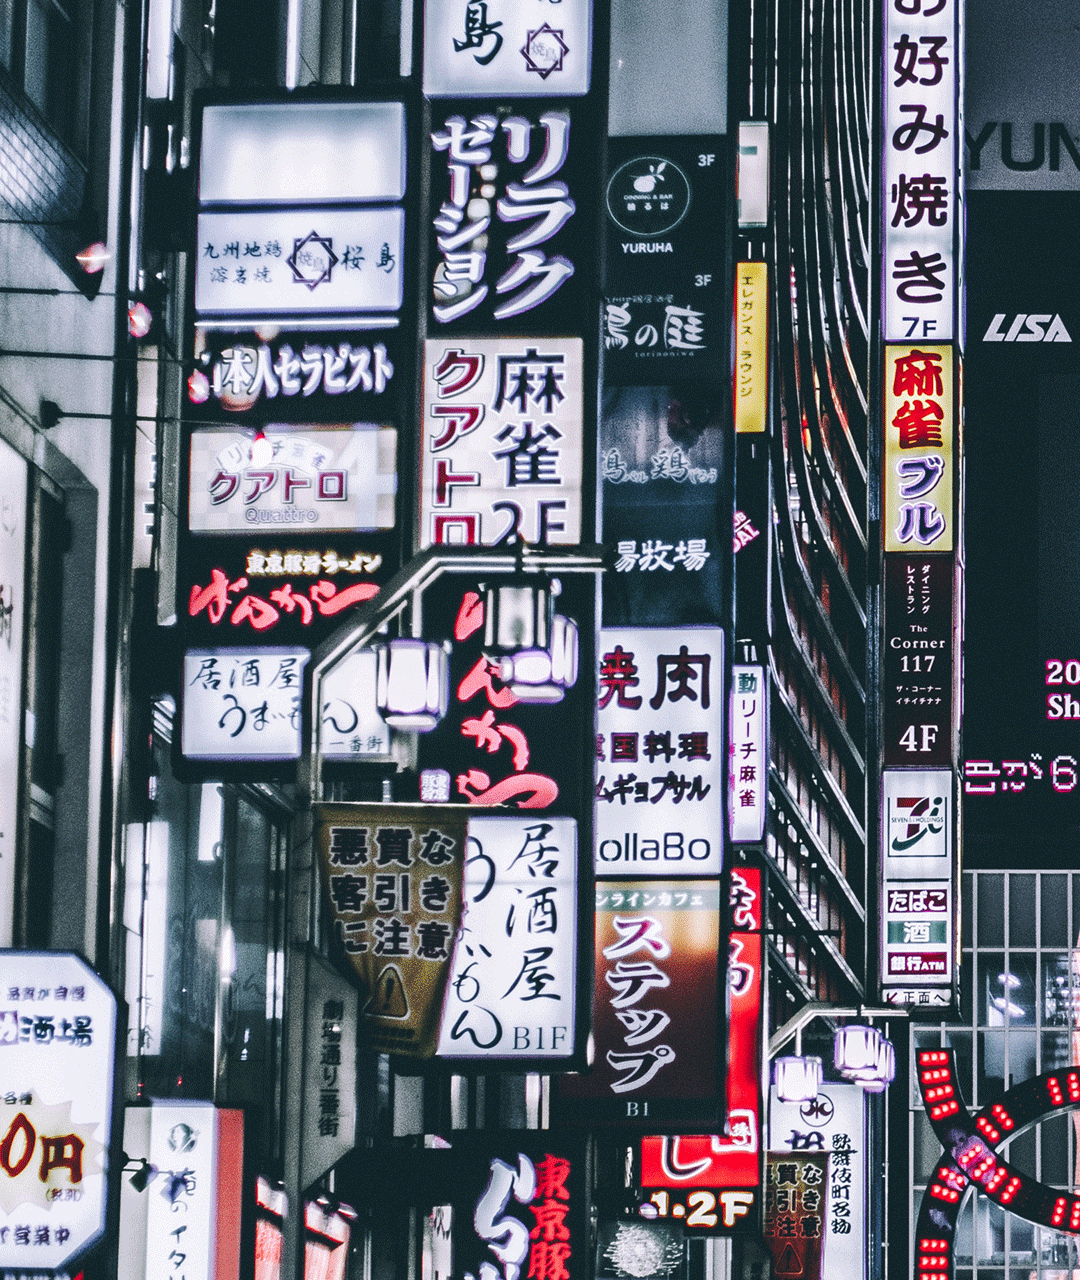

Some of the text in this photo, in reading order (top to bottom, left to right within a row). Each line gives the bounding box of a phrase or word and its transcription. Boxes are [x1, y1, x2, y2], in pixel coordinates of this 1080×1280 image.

[698, 154, 715, 167] 3F
[431, 117, 496, 321] ゼーション
[493, 112, 576, 320] リラク
[340, 245, 396, 274] 桜島
[621, 242, 674, 254] YURUHA
[694, 274, 712, 287] 3F
[902, 316, 938, 338] 7F
[207, 343, 395, 398] 本人セラピスト
[491, 348, 567, 488] 麻雀
[431, 347, 486, 546] クアトロ
[208, 469, 348, 505] クアトロ
[245, 506, 318, 523] Quattro
[906, 564, 916, 614] レストラン
[921, 564, 931, 614] ダイニング
[890, 636, 946, 649] Corner
[910, 624, 928, 633] The
[189, 657, 301, 690] 居酒屋
[900, 655, 936, 672] 117
[896, 697, 942, 705] イチイチナナ
[899, 725, 939, 752] 4F
[739, 699, 758, 808] リーチ麻雀
[330, 826, 454, 868] 悪質な
[597, 832, 711, 862] ollaBo
[331, 873, 454, 913] 客引き
[889, 890, 947, 912] たばこ
[500, 823, 562, 1003] 居酒屋
[332, 918, 452, 960] に注意
[903, 922, 931, 943] 酒
[602, 913, 676, 1094] ステップ
[903, 991, 946, 1004] 正面へ
[513, 1026, 568, 1050] B1F
[626, 1101, 650, 1117] B1
